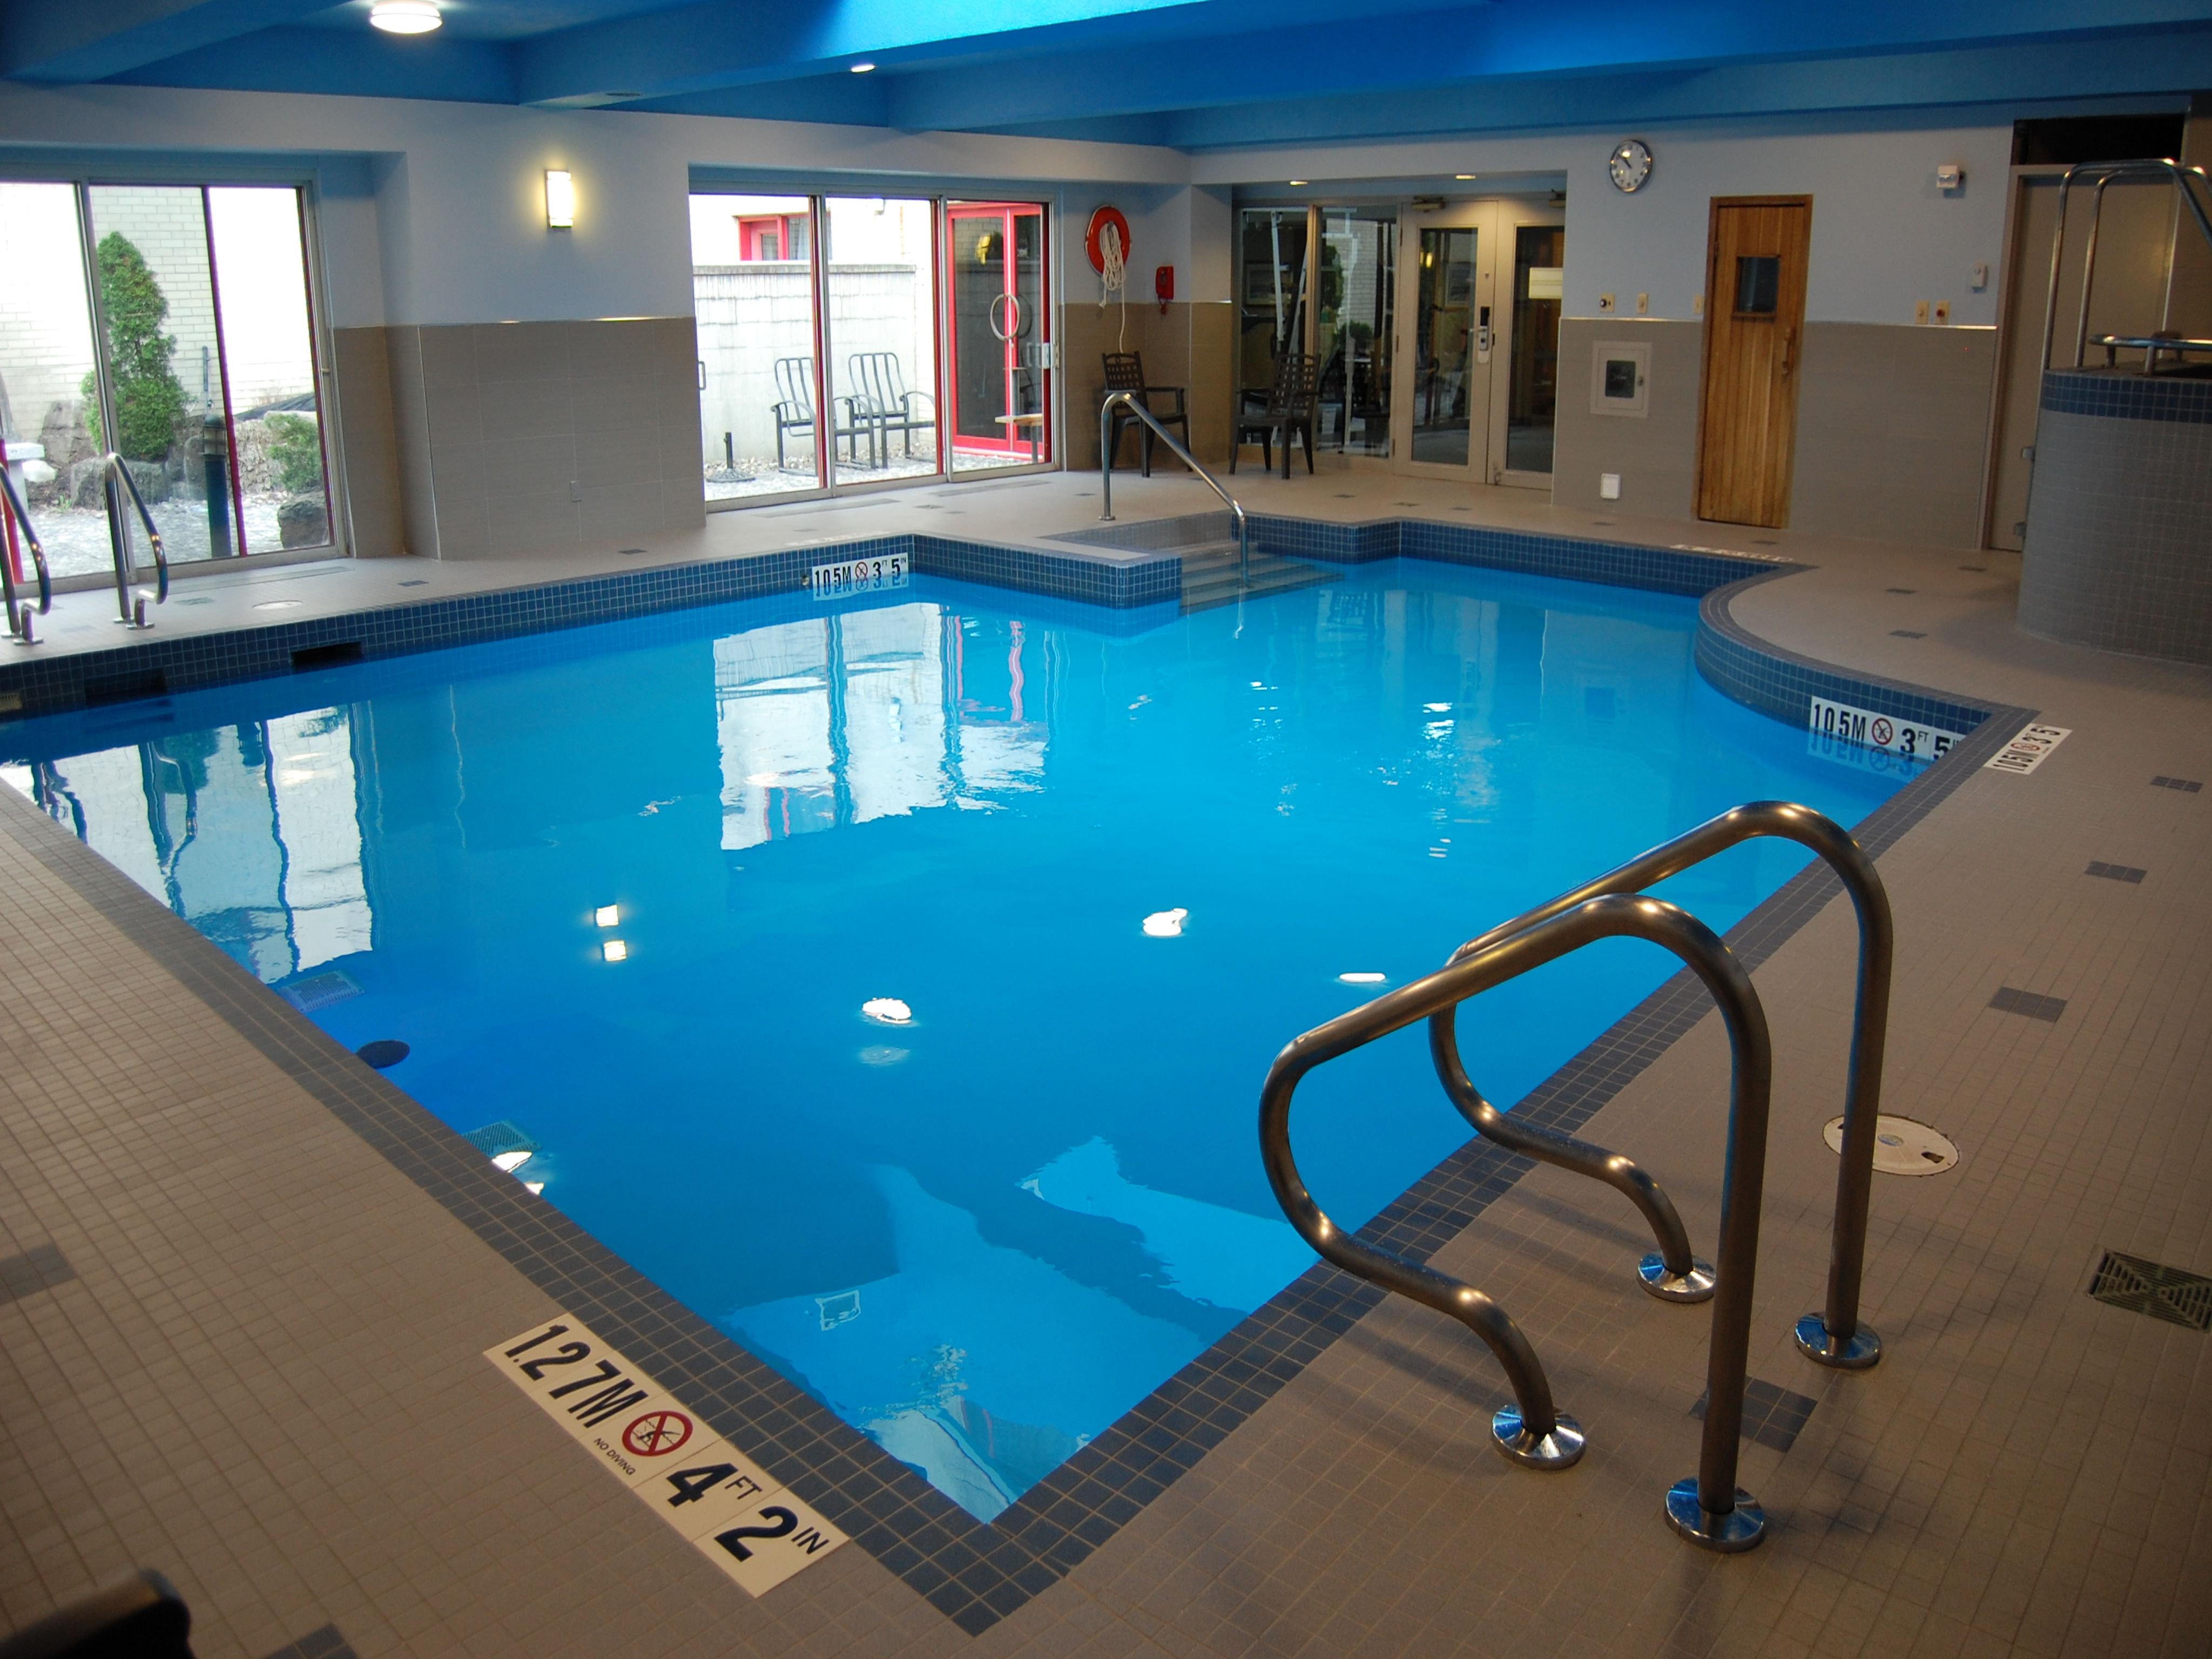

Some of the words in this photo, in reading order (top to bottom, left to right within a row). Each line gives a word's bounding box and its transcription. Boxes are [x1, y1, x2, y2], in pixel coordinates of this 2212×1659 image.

[873, 562, 881, 579] 3
[892, 558, 900, 577] 5
[1900, 728, 1916, 754] 3
[1918, 731, 1928, 742] FT
[1933, 736, 1950, 760] 5
[504, 1325, 649, 1428] 1.27M
[594, 1437, 609, 1450] NO
[606, 1449, 636, 1475] DIVING
[666, 1462, 739, 1508] 4
[724, 1475, 763, 1500] FT
[714, 1506, 798, 1562] 2
[791, 1527, 830, 1555] IN
